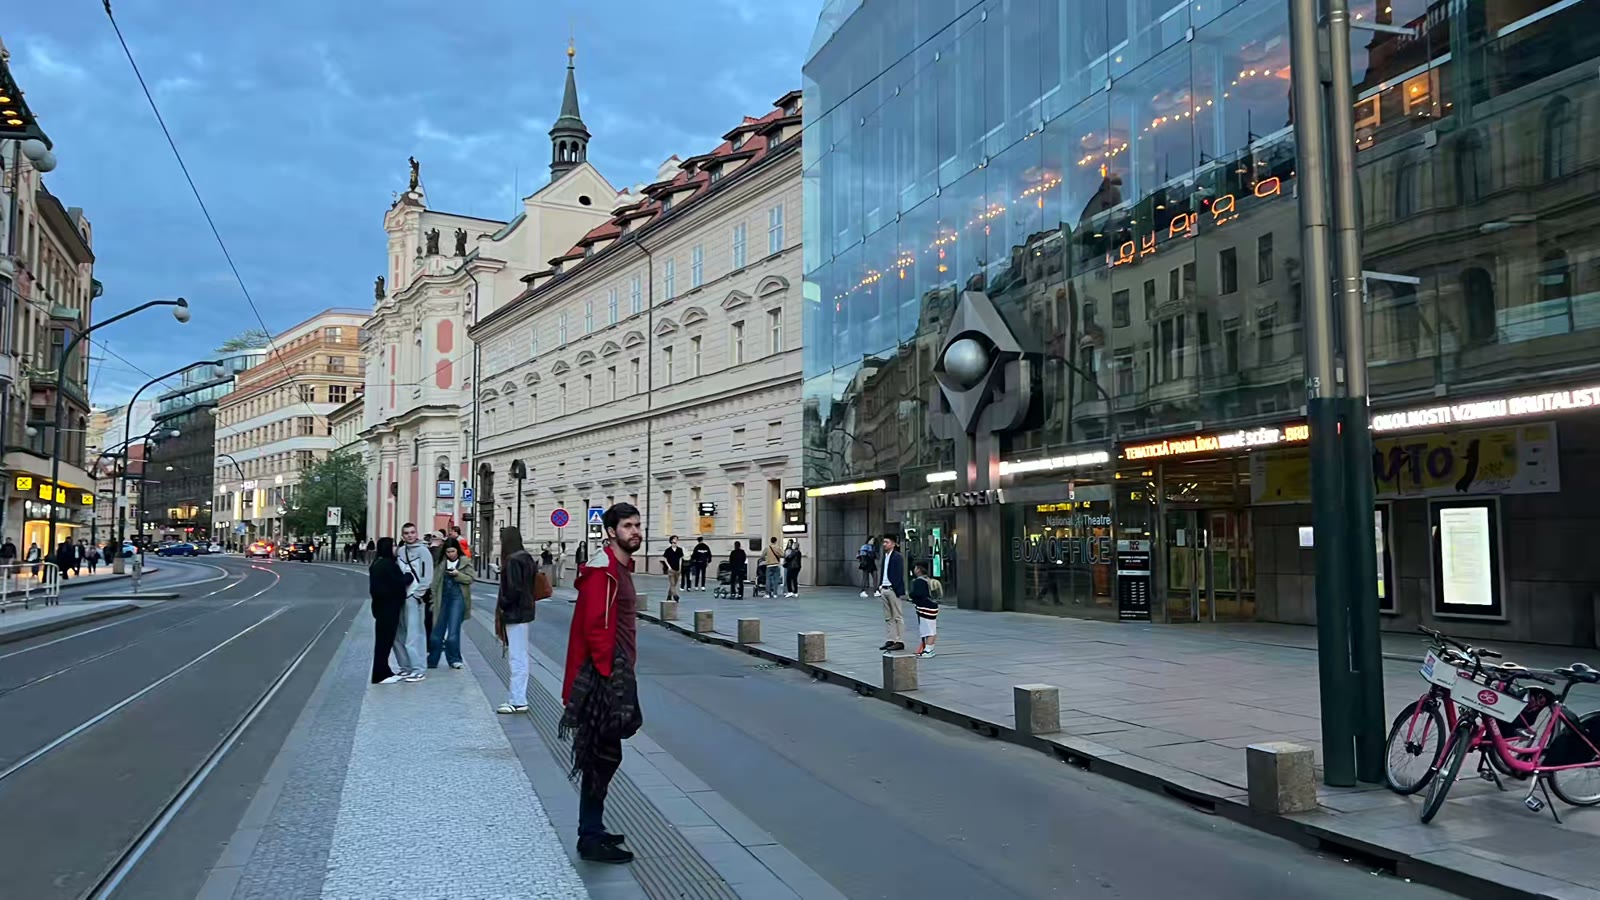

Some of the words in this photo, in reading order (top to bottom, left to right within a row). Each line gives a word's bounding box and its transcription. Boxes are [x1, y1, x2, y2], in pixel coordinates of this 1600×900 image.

[1125, 441, 1169, 460] TEMATICKÁ
[1046, 515, 1073, 526] National
[1083, 514, 1112, 525] Theatre
[1012, 536, 1044, 562] BOX
[1047, 536, 1111, 565] OFFICE
